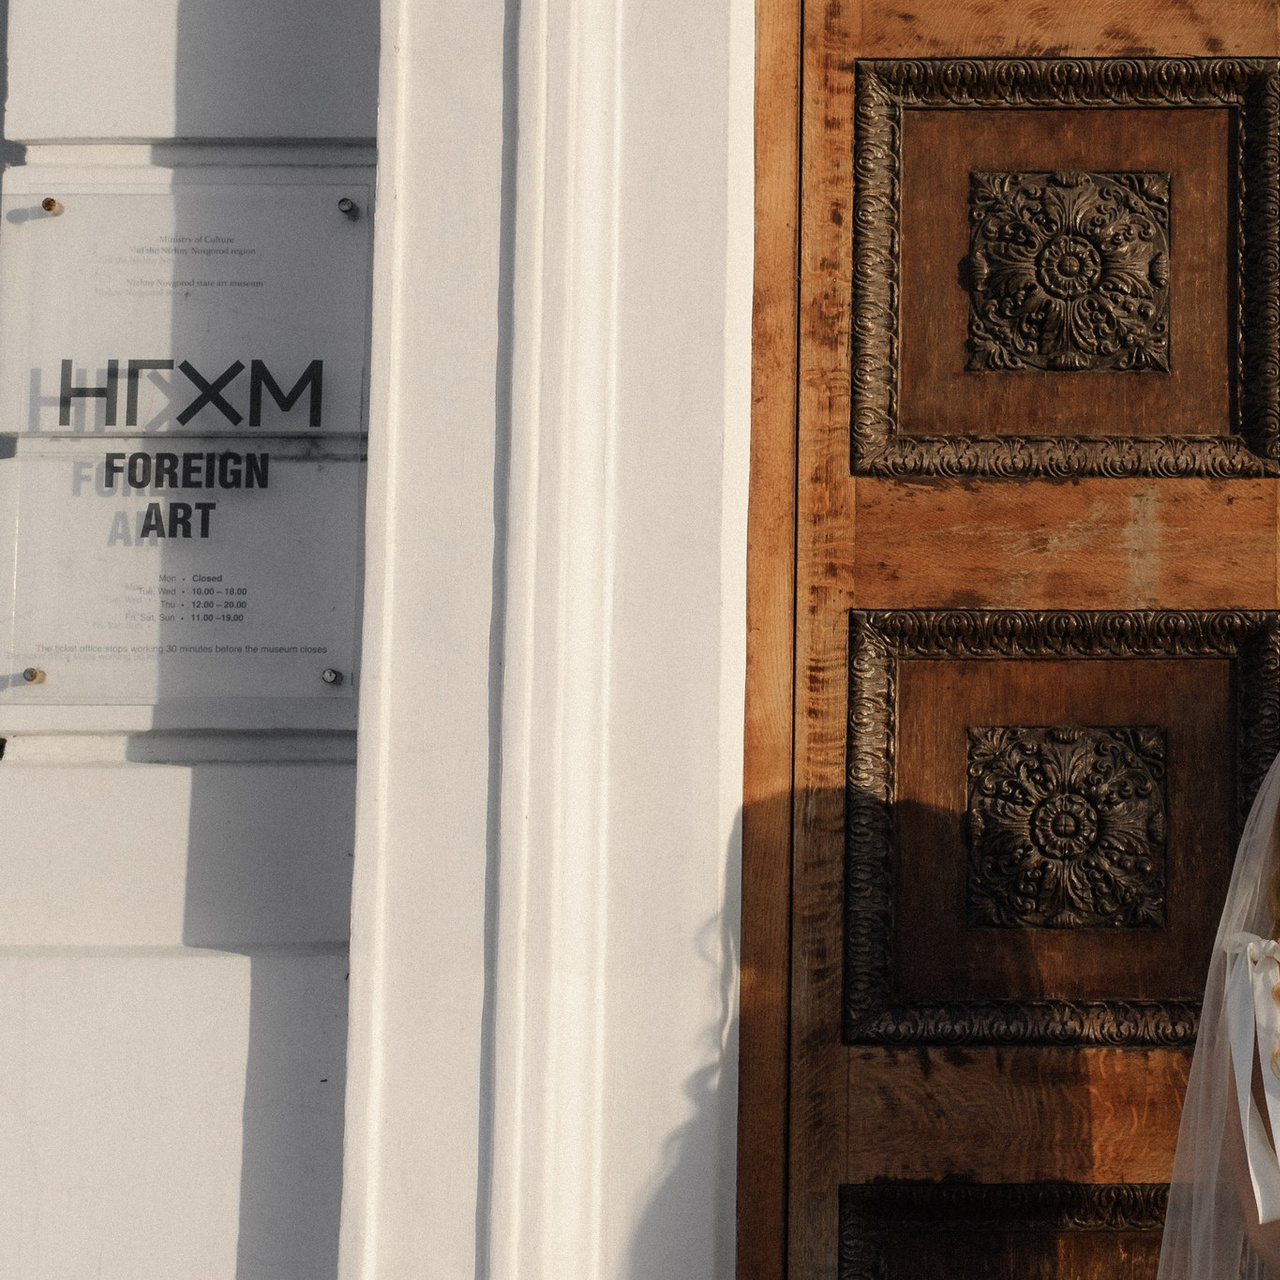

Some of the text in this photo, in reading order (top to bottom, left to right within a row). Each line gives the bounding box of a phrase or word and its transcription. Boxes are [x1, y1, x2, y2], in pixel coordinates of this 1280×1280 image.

[231, 247, 256, 256] region
[59, 359, 323, 427] НГХМ
[104, 452, 269, 489] FOREIGN
[140, 502, 216, 538] ART
[159, 574, 223, 582] Mon Closed
[192, 588, 215, 596] 10.00
[224, 588, 247, 596] 18.00
[160, 601, 176, 609] Thu
[192, 601, 214, 609] 12.00
[223, 601, 247, 609] 20.00
[191, 614, 214, 622] 11.00
[166, 644, 177, 653] 30
[179, 645, 213, 653] minutes
[215, 645, 242, 653] before
[245, 645, 258, 653] the
[260, 645, 298, 653] museum
[300, 645, 328, 653] closes
